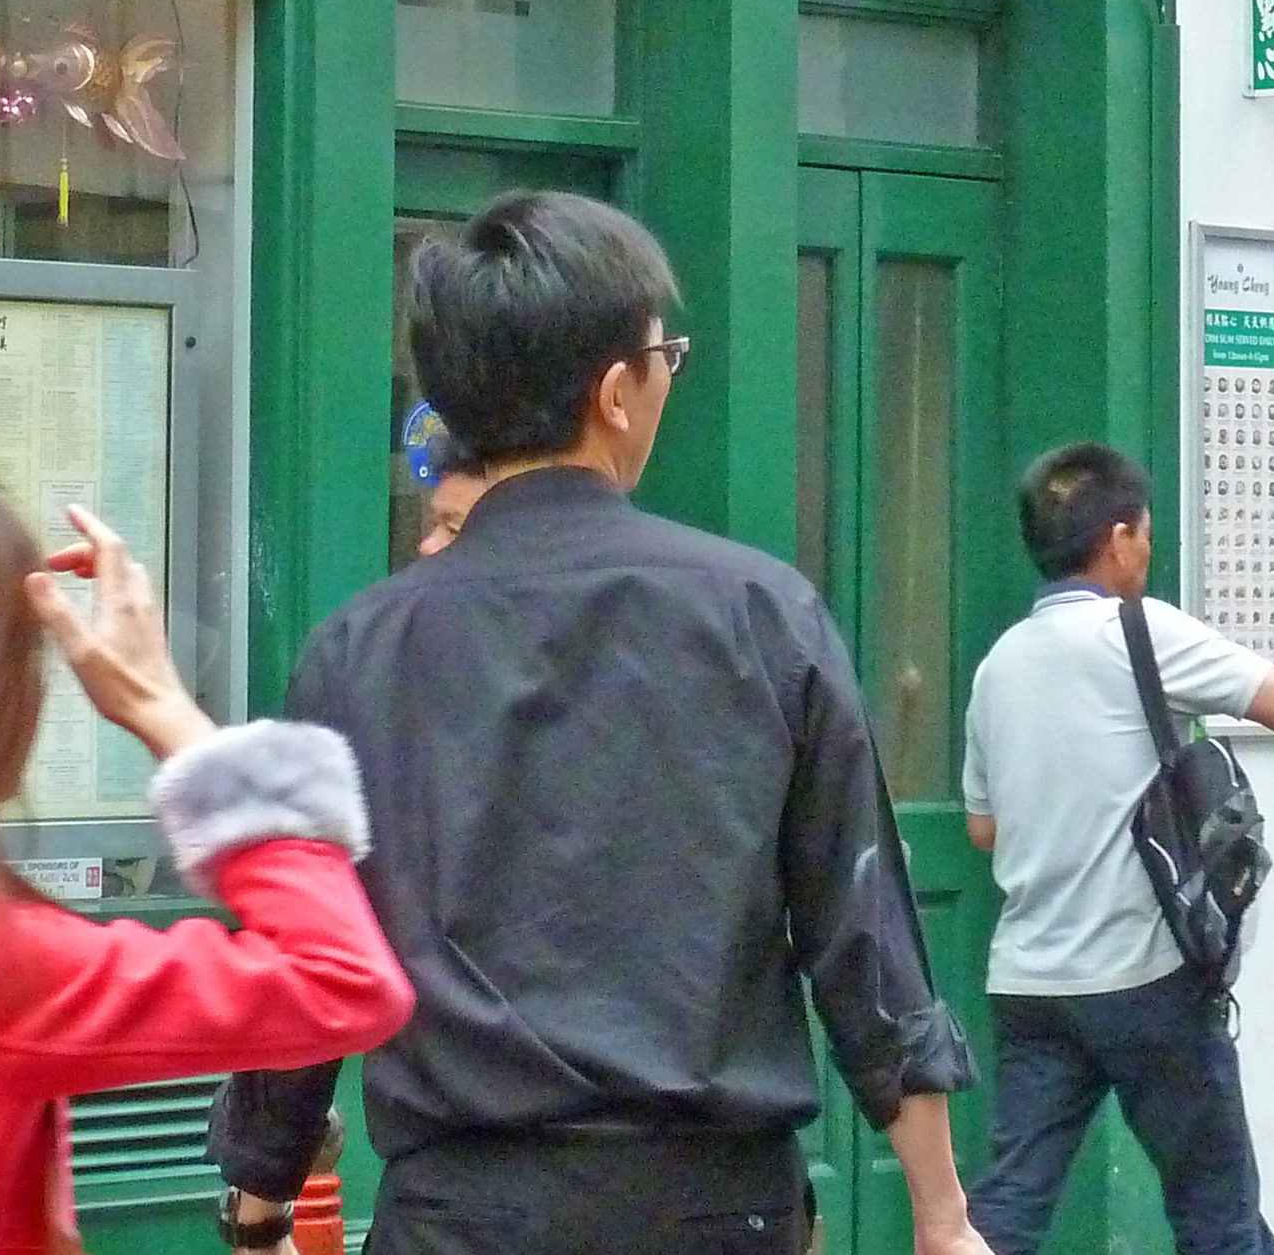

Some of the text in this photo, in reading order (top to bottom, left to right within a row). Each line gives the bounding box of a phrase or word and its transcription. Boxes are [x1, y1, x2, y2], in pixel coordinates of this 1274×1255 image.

[1207, 275, 1270, 296] Young Cheng
[1205, 333, 1218, 344] DIM
[1220, 334, 1234, 344] SUM
[1235, 334, 1259, 346] SERVED
[27, 861, 80, 871] SPONSORS OF
